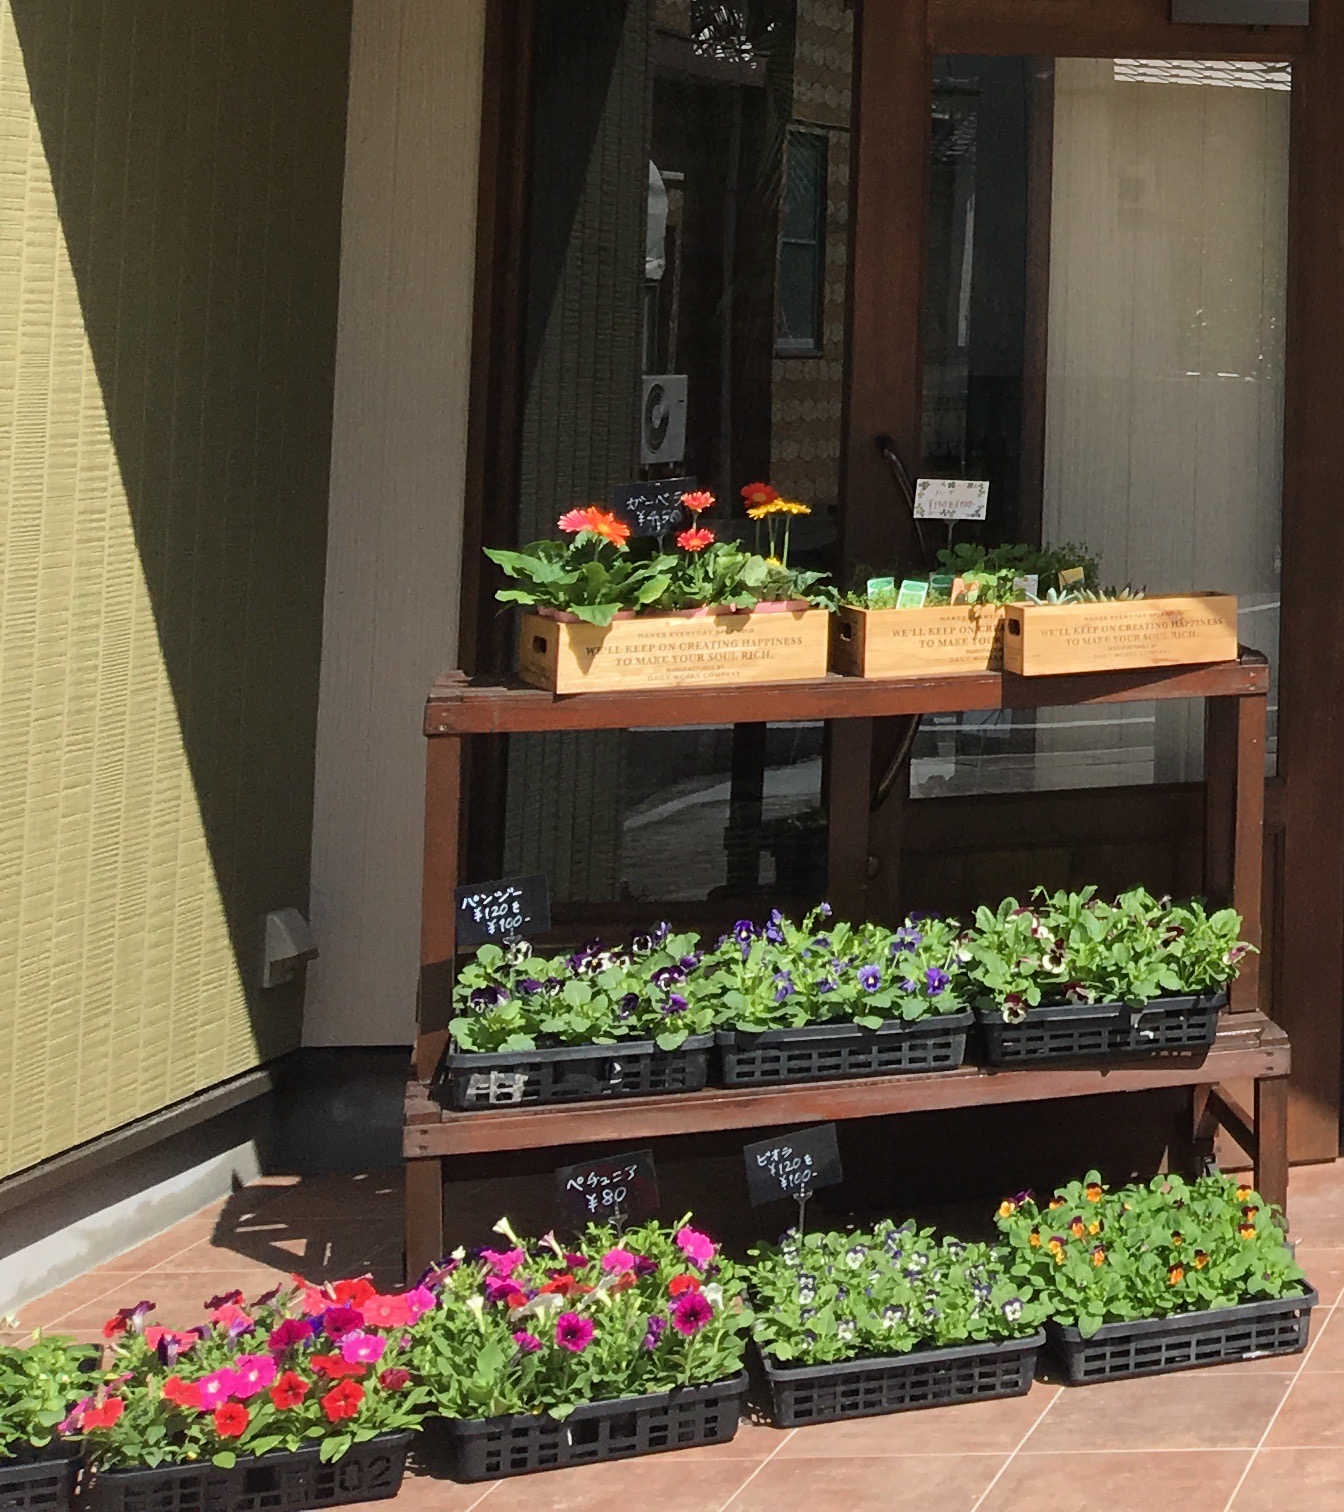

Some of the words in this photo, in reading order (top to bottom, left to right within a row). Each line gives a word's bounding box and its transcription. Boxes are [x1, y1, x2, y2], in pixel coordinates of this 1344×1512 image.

[891, 628, 926, 638] WE'LL
[928, 626, 957, 637] KEEP
[958, 625, 974, 635] ON
[1040, 627, 1071, 637] WE'LL
[1073, 625, 1100, 635] KEEP
[1101, 624, 1117, 633] ON
[1118, 620, 1168, 632] CREATING
[1171, 617, 1223, 629] HAPPINESS
[585, 645, 622, 656] WE'LL
[625, 643, 656, 654] KEEP
[658, 642, 676, 652] ON
[679, 639, 739, 651] CREATING
[742, 636, 803, 648] HAPPINESS
[918, 639, 935, 649] TO
[937, 637, 968, 648] MAKE
[1065, 638, 1080, 646] TO
[1082, 635, 1111, 645] MAKE
[1112, 633, 1140, 644] YOUR
[615, 657, 632, 667] TO
[635, 655, 669, 666] MAKE
[672, 653, 704, 664] YOUR
[707, 651, 738, 662] SOUL
[461, 886, 523, 910] パンジー
[756, 1146, 793, 1167] ビオラ
[566, 1164, 638, 1192] ペチュニア
[585, 1186, 627, 1213] ¥80
